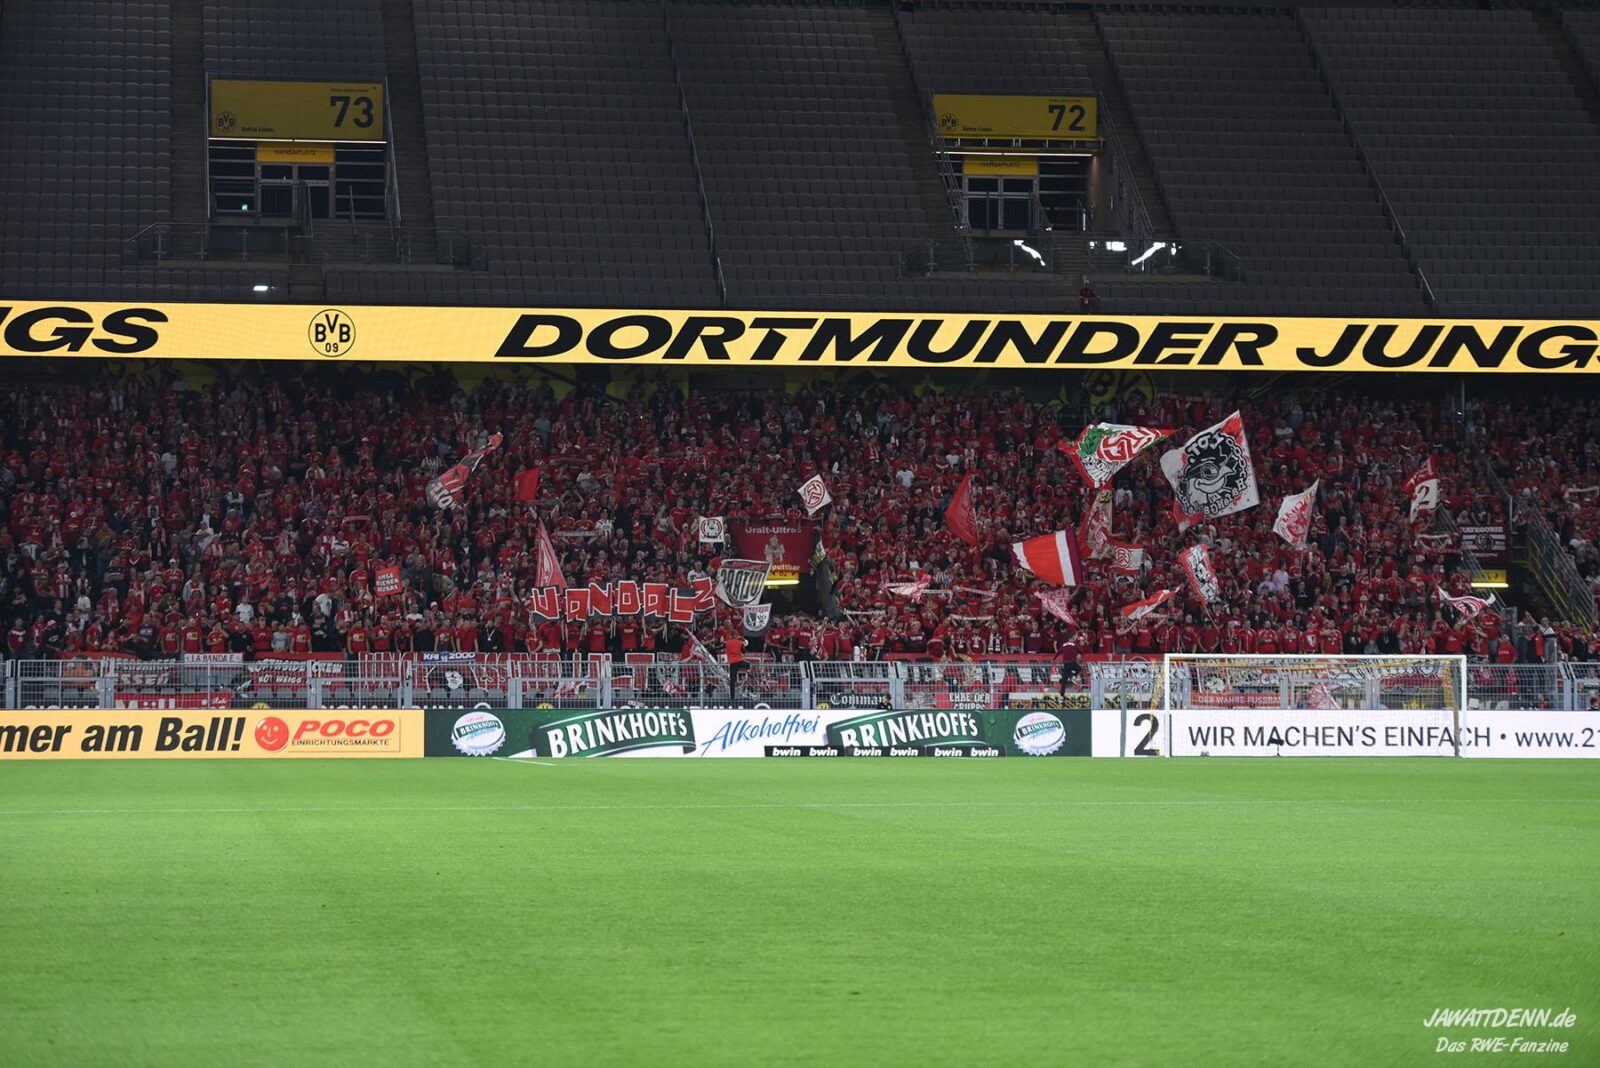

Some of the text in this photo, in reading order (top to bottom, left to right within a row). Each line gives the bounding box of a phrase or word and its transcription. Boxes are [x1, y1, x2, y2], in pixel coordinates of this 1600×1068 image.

[330, 96, 374, 128] 73
[1048, 104, 1086, 132] 72
[0, 306, 168, 354] GS
[314, 314, 350, 342] BVB
[325, 343, 339, 353] 09
[494, 314, 1600, 369] DORTMUNDER JUNG
[81, 725, 142, 752] am
[156, 717, 246, 752] Ball!
[293, 720, 396, 740] POCO
[701, 713, 820, 756] Alkoholfrei
[1188, 726, 1236, 746] WIR
[1514, 727, 1600, 747] www.2
[772, 747, 801, 757] bwin
[809, 747, 838, 757] bwin
[853, 747, 882, 757] bwin
[890, 747, 918, 757] bwin
[934, 747, 962, 757] bwin
[970, 747, 999, 757] bwin
